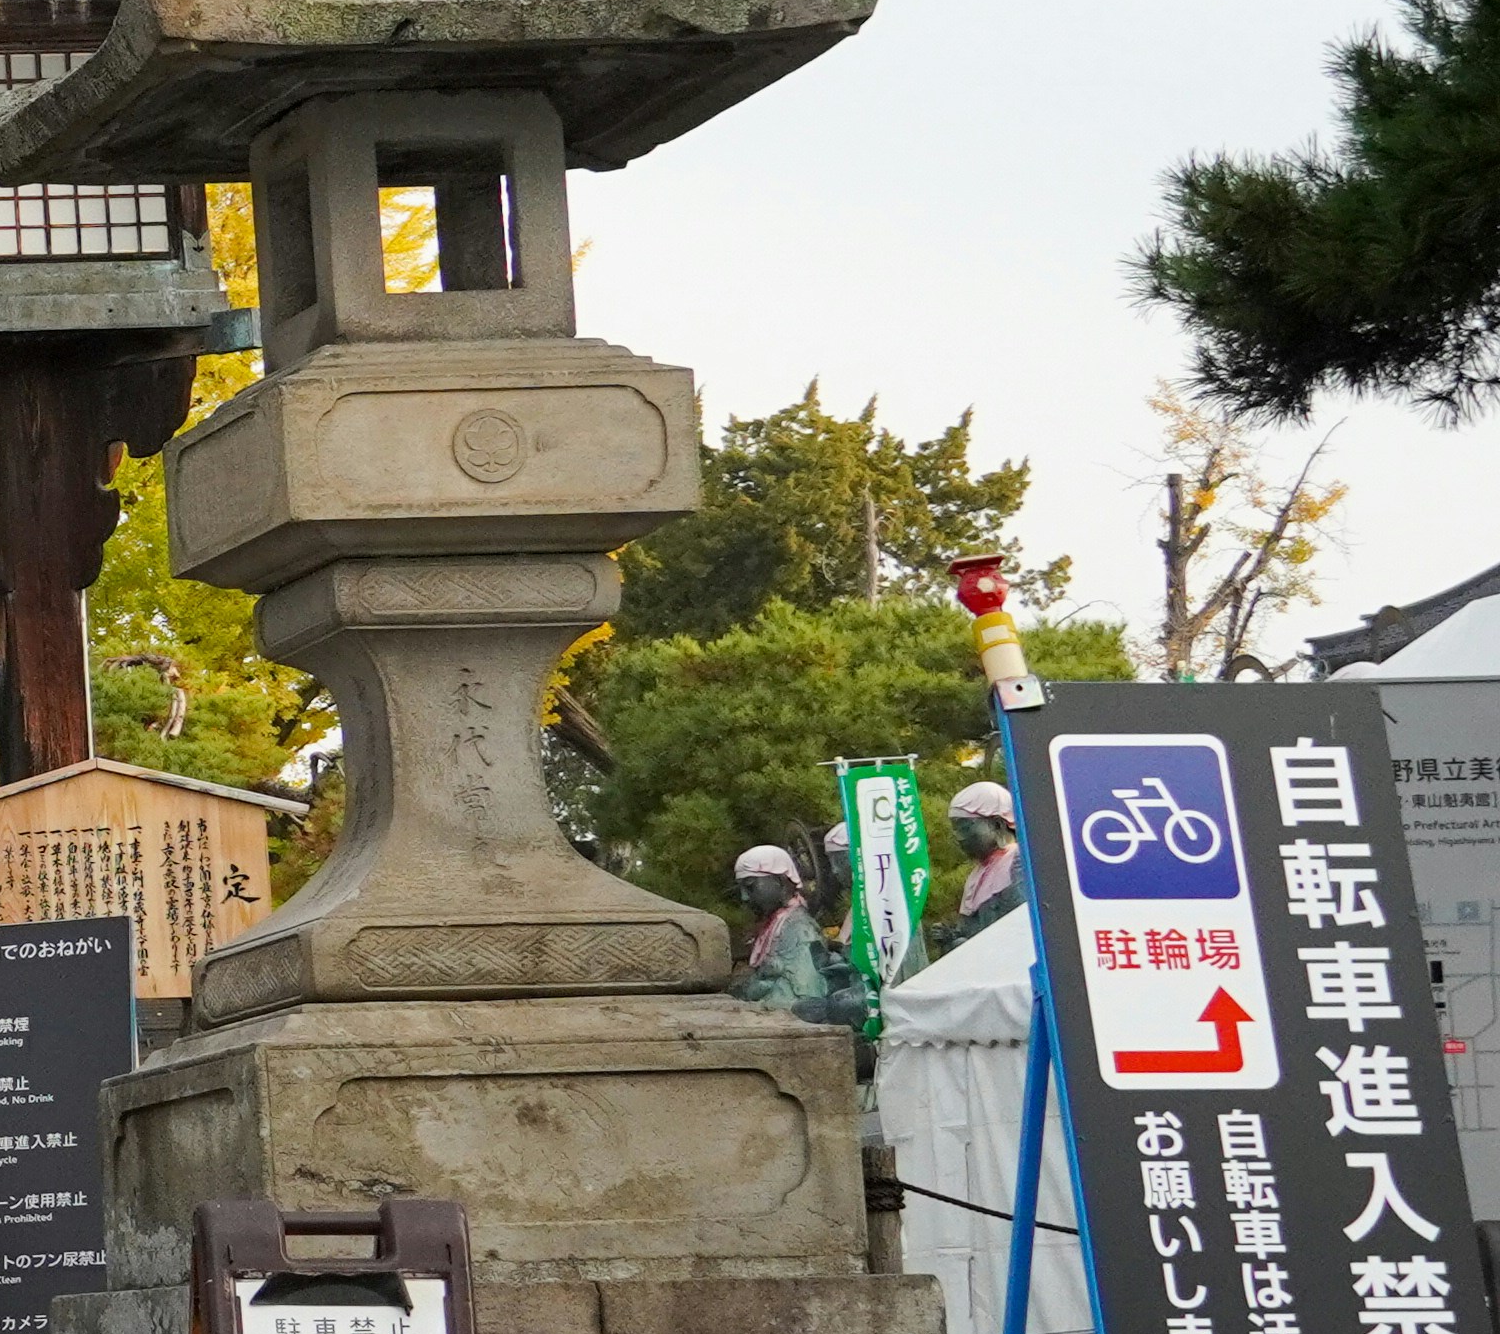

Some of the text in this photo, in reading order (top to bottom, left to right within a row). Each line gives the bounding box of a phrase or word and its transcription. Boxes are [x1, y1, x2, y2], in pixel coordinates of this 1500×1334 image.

[1392, 758, 1500, 782] 野県立美
[221, 864, 261, 904] 定
[1094, 928, 1241, 971] 駐輪場
[12, 1095, 27, 1105] No
[28, 1093, 54, 1104] Drink
[3, 1213, 53, 1224] Prohibited
